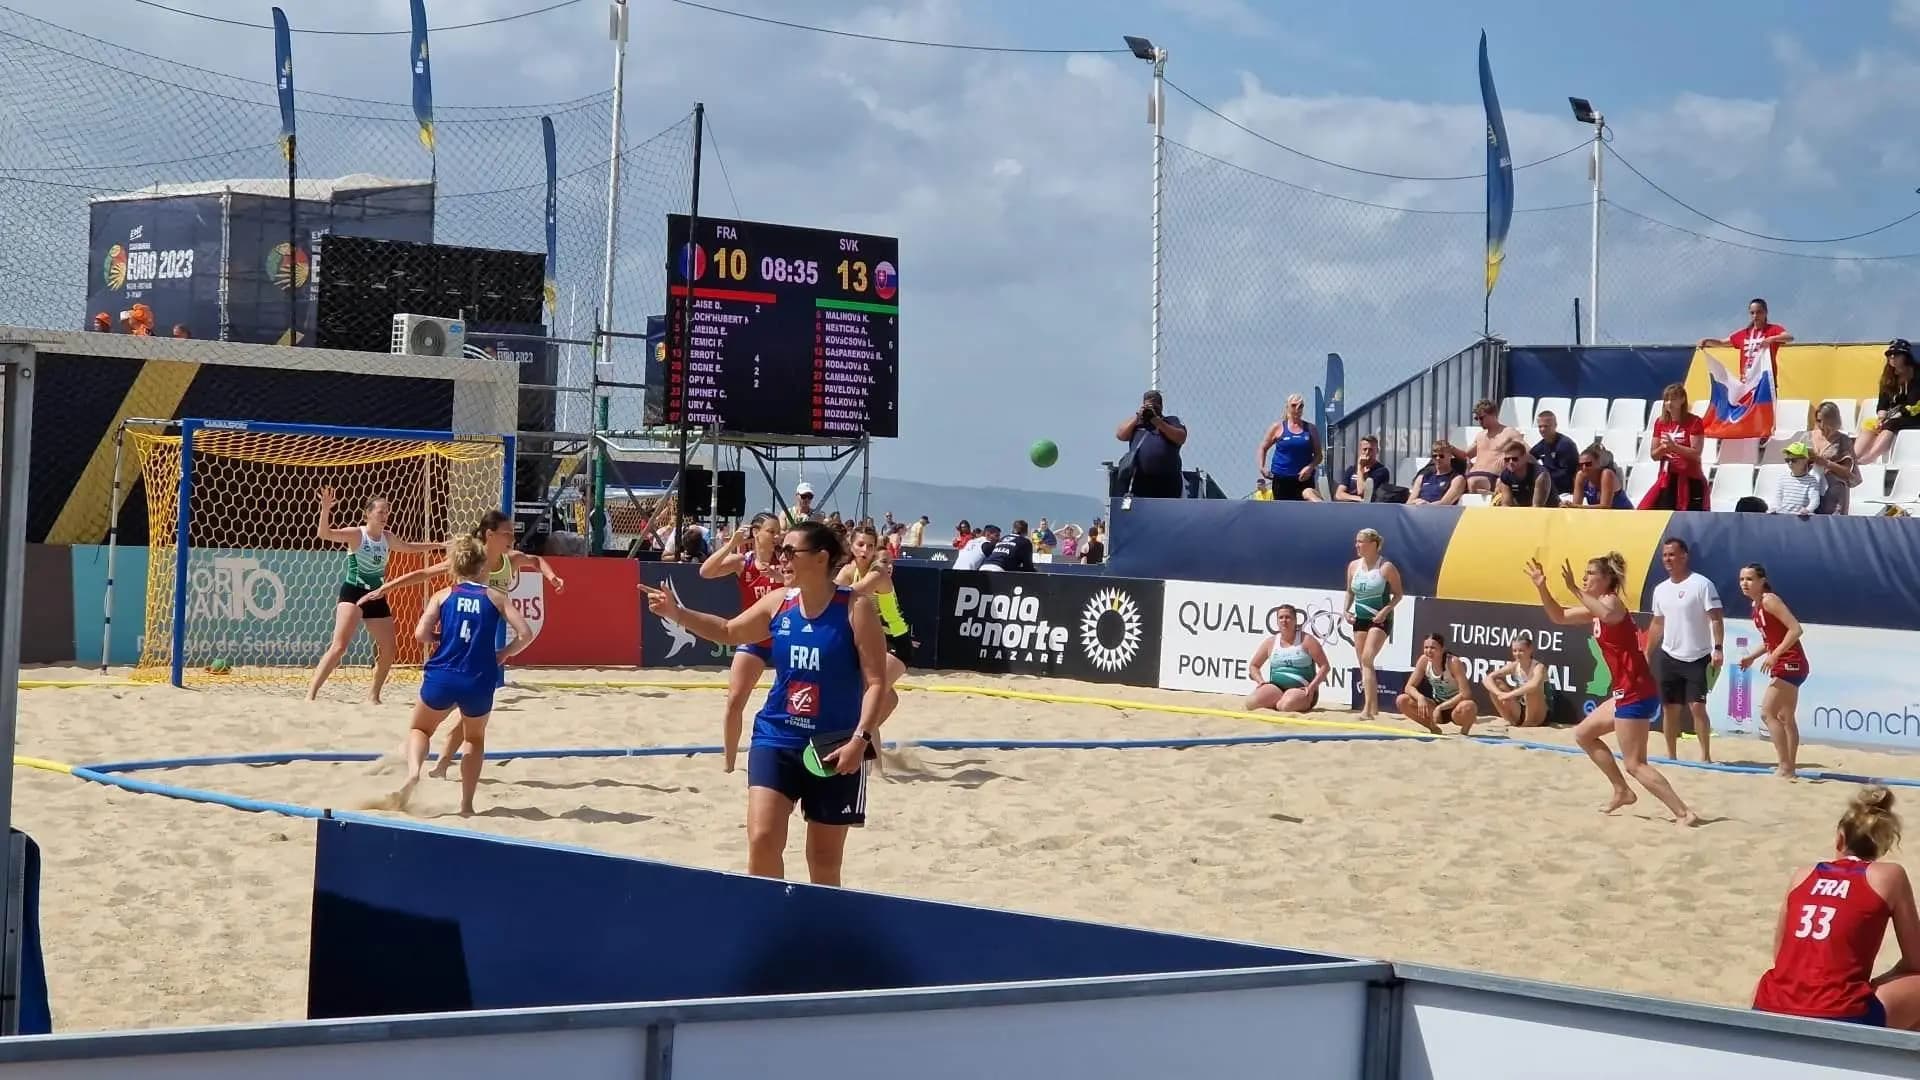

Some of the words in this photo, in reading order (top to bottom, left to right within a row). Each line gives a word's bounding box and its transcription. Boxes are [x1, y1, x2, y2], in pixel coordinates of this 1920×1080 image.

[717, 226, 737, 240] FRA
[839, 238, 859, 251] SVK
[127, 251, 157, 280] EURO
[158, 249, 194, 279] 2023
[713, 248, 747, 280] 10
[761, 256, 819, 285] 08:35
[837, 260, 868, 292] 13
[755, 305, 761, 313] 2
[888, 316, 894, 325] 4
[515, 351, 533, 363] 2023
[754, 354, 760, 362] 4
[754, 367, 760, 376] 2
[753, 379, 759, 388] 2
[888, 401, 894, 410] 2
[456, 597, 481, 614] FRA
[954, 586, 1040, 622] Praia
[460, 619, 471, 643] 4
[960, 617, 983, 637] do
[982, 620, 1069, 652] norte
[1538, 630, 1564, 652] DE
[789, 644, 820, 672] FRA
[1811, 878, 1851, 899] FRA
[1794, 904, 1837, 941] 33
